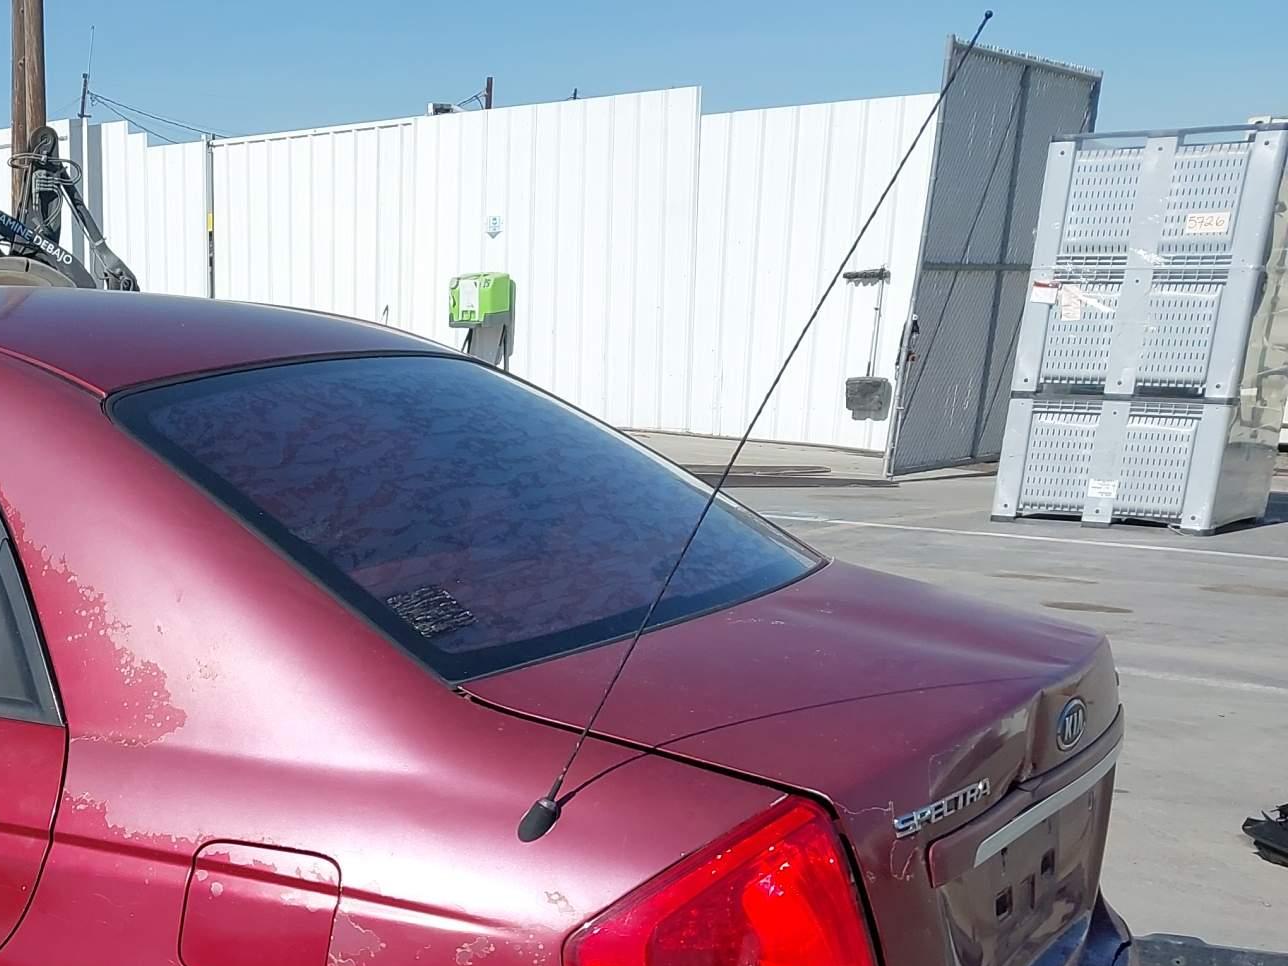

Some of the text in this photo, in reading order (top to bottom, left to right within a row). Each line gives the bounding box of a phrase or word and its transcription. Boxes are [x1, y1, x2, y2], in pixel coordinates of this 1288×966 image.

[1187, 215, 1225, 230] 5726
[33, 234, 73, 265] DEBAJO
[894, 778, 991, 838] SPECTRA
